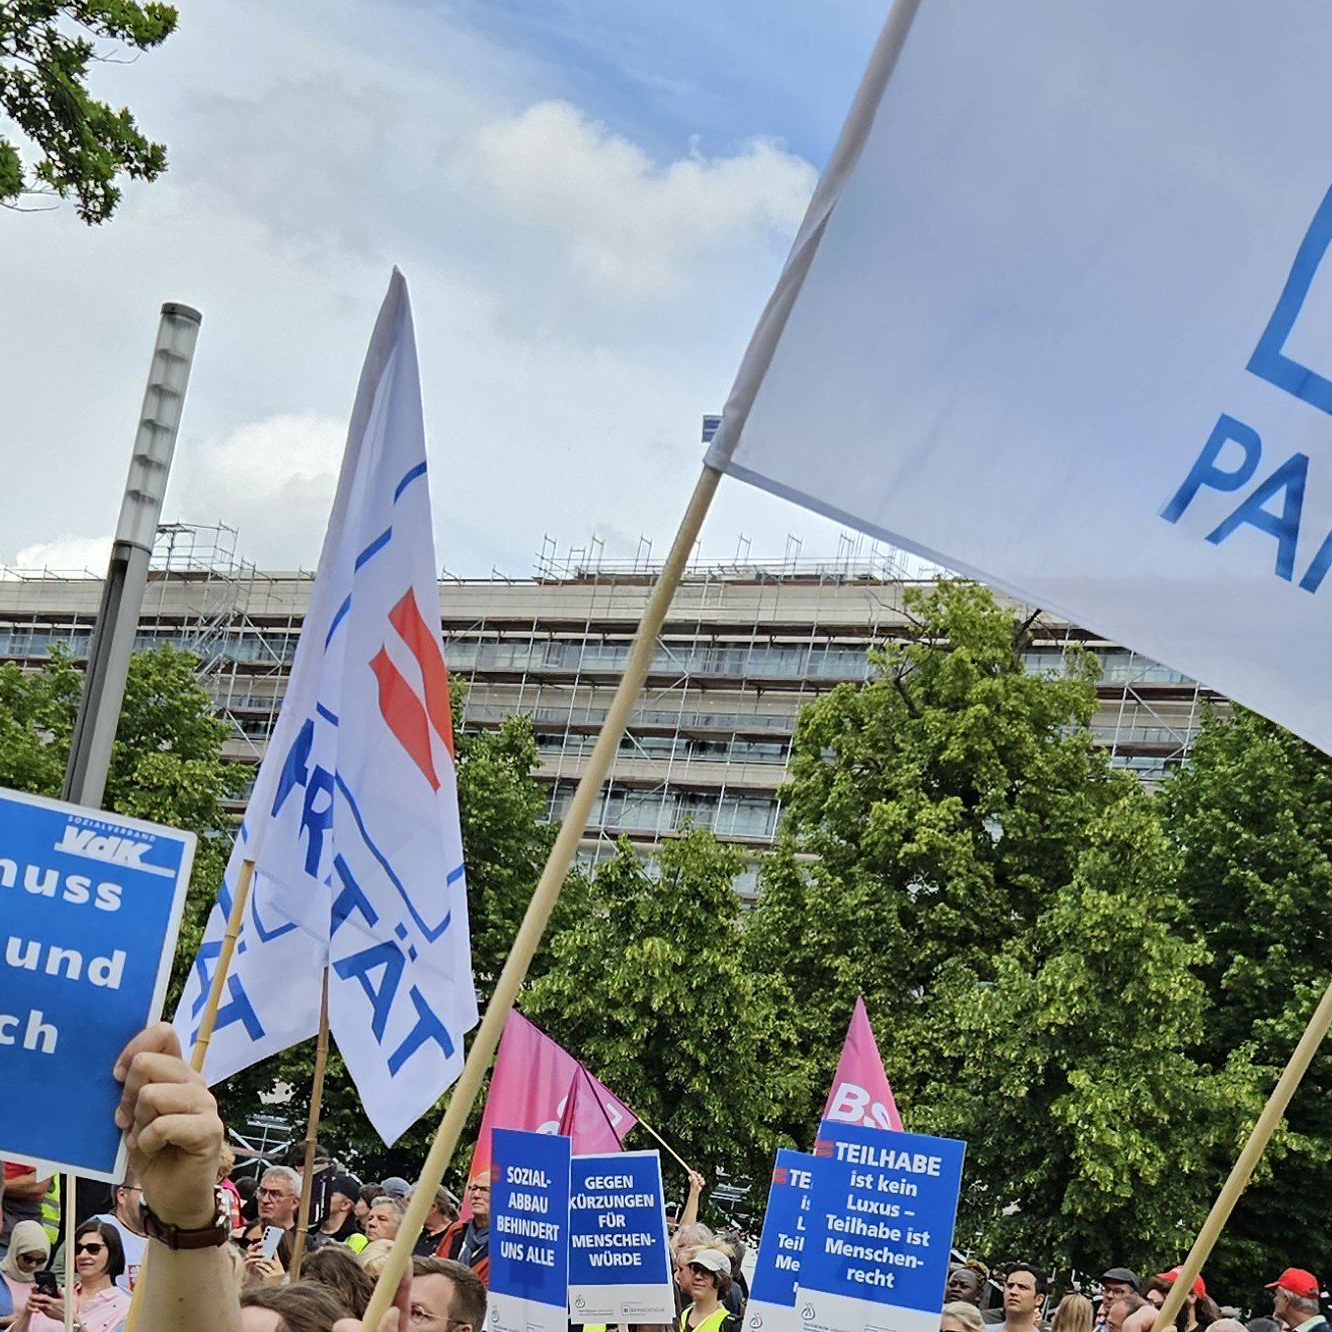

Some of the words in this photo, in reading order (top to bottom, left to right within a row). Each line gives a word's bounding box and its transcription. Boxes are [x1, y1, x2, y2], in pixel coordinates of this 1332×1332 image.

[68, 814, 157, 843] SOZIALVERBAND
[60, 824, 153, 868] VdK
[4, 935, 128, 990] und
[835, 1141, 943, 1177] TEILHABE
[506, 1165, 552, 1189] SOZIAL-
[583, 1175, 634, 1190] GEGEN
[789, 1167, 813, 1190] TE
[849, 1169, 874, 1190] ist
[877, 1174, 918, 1197] kein
[507, 1191, 549, 1214] ABBAU
[846, 1194, 901, 1218] Luxus
[496, 1215, 560, 1242] BEHINDERT
[597, 1212, 626, 1229] FÜR
[825, 1213, 902, 1242] Teilhabe
[905, 1227, 931, 1247] ist
[500, 1240, 524, 1260] UNS
[525, 1244, 555, 1267] ALLE
[571, 1233, 657, 1249] MENSCHEN-
[824, 1237, 925, 1267] Menschen-
[588, 1250, 642, 1267] WÜRDE
[846, 1265, 896, 1290] recht
